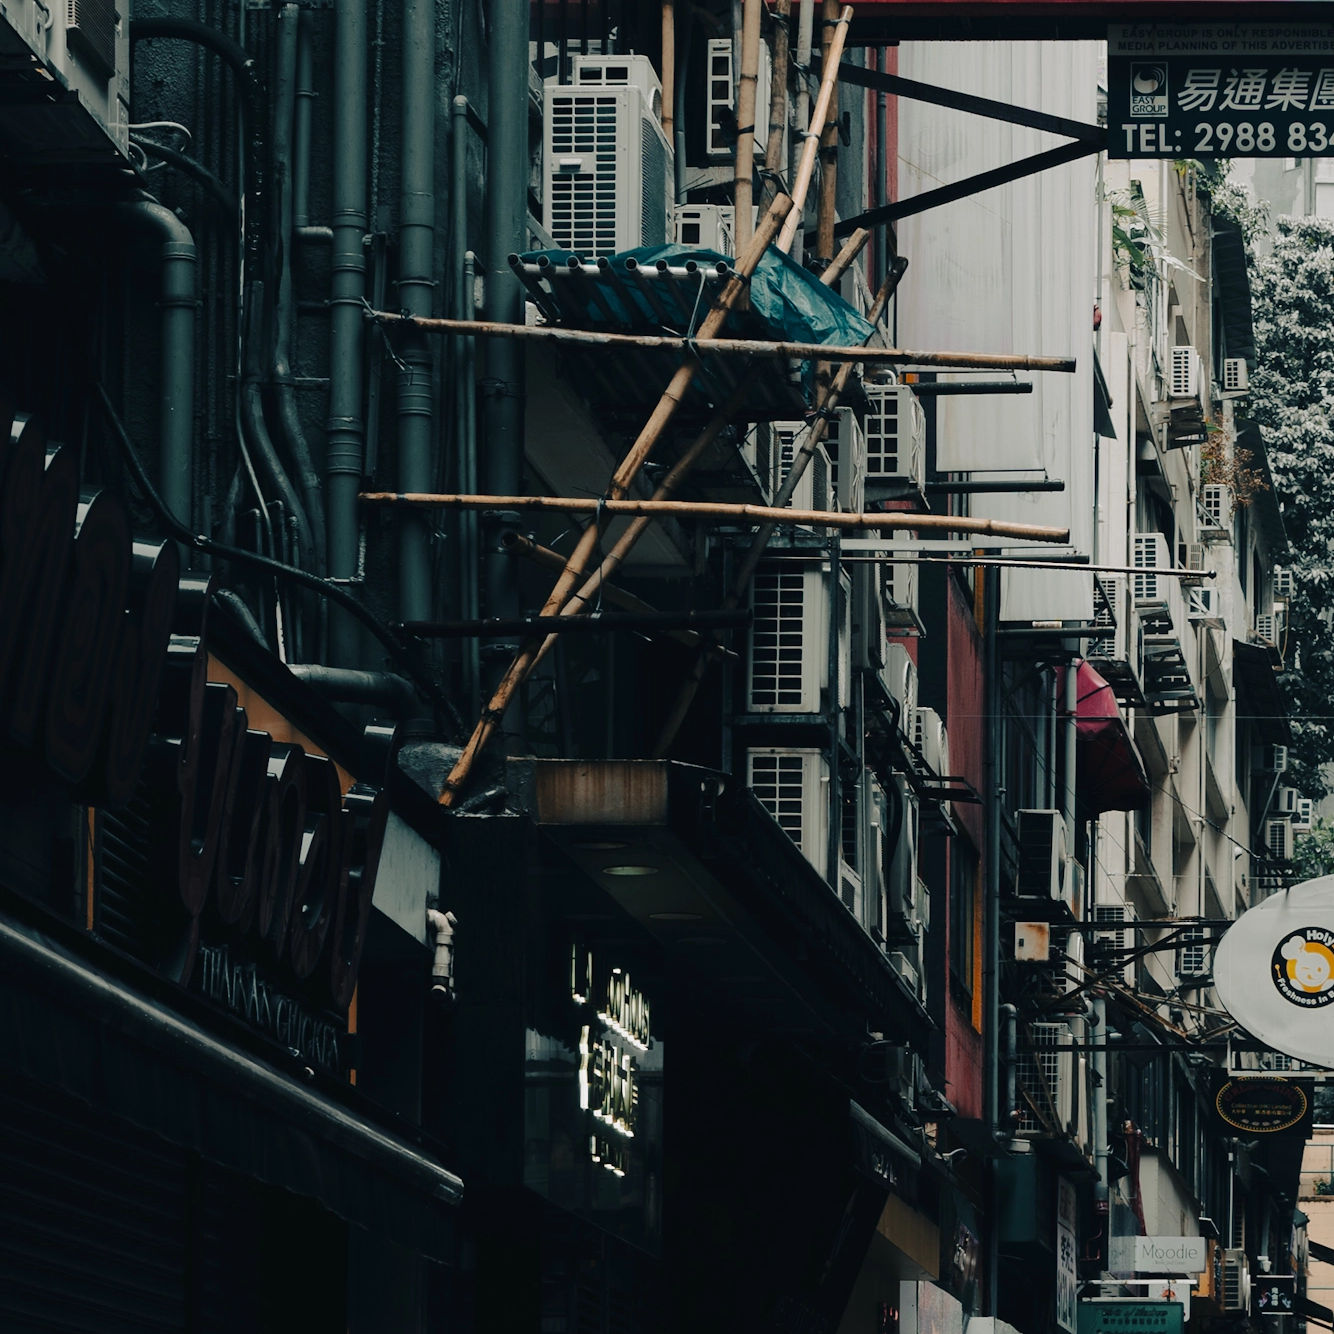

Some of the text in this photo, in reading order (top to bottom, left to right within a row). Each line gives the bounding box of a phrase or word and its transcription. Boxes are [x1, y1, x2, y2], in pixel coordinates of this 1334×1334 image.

[1122, 29, 1153, 38] EASY
[1157, 28, 1199, 38] GROUP
[1202, 29, 1213, 38] IS
[1217, 29, 1248, 38] ONLY
[1252, 29, 1334, 38] RESPONSIBLE
[1118, 41, 1155, 50] MEDIA
[1158, 41, 1218, 50] PLANNING
[1222, 41, 1238, 50] OF
[1242, 41, 1267, 50] THIS
[1132, 96, 1156, 104] EASY
[1132, 105, 1166, 113] GROUP
[1121, 123, 1182, 153] TEL:
[1194, 122, 1277, 153] 2988
[1277, 978, 1317, 1005] Freshness
[1142, 1243, 1199, 1260] Moodie
